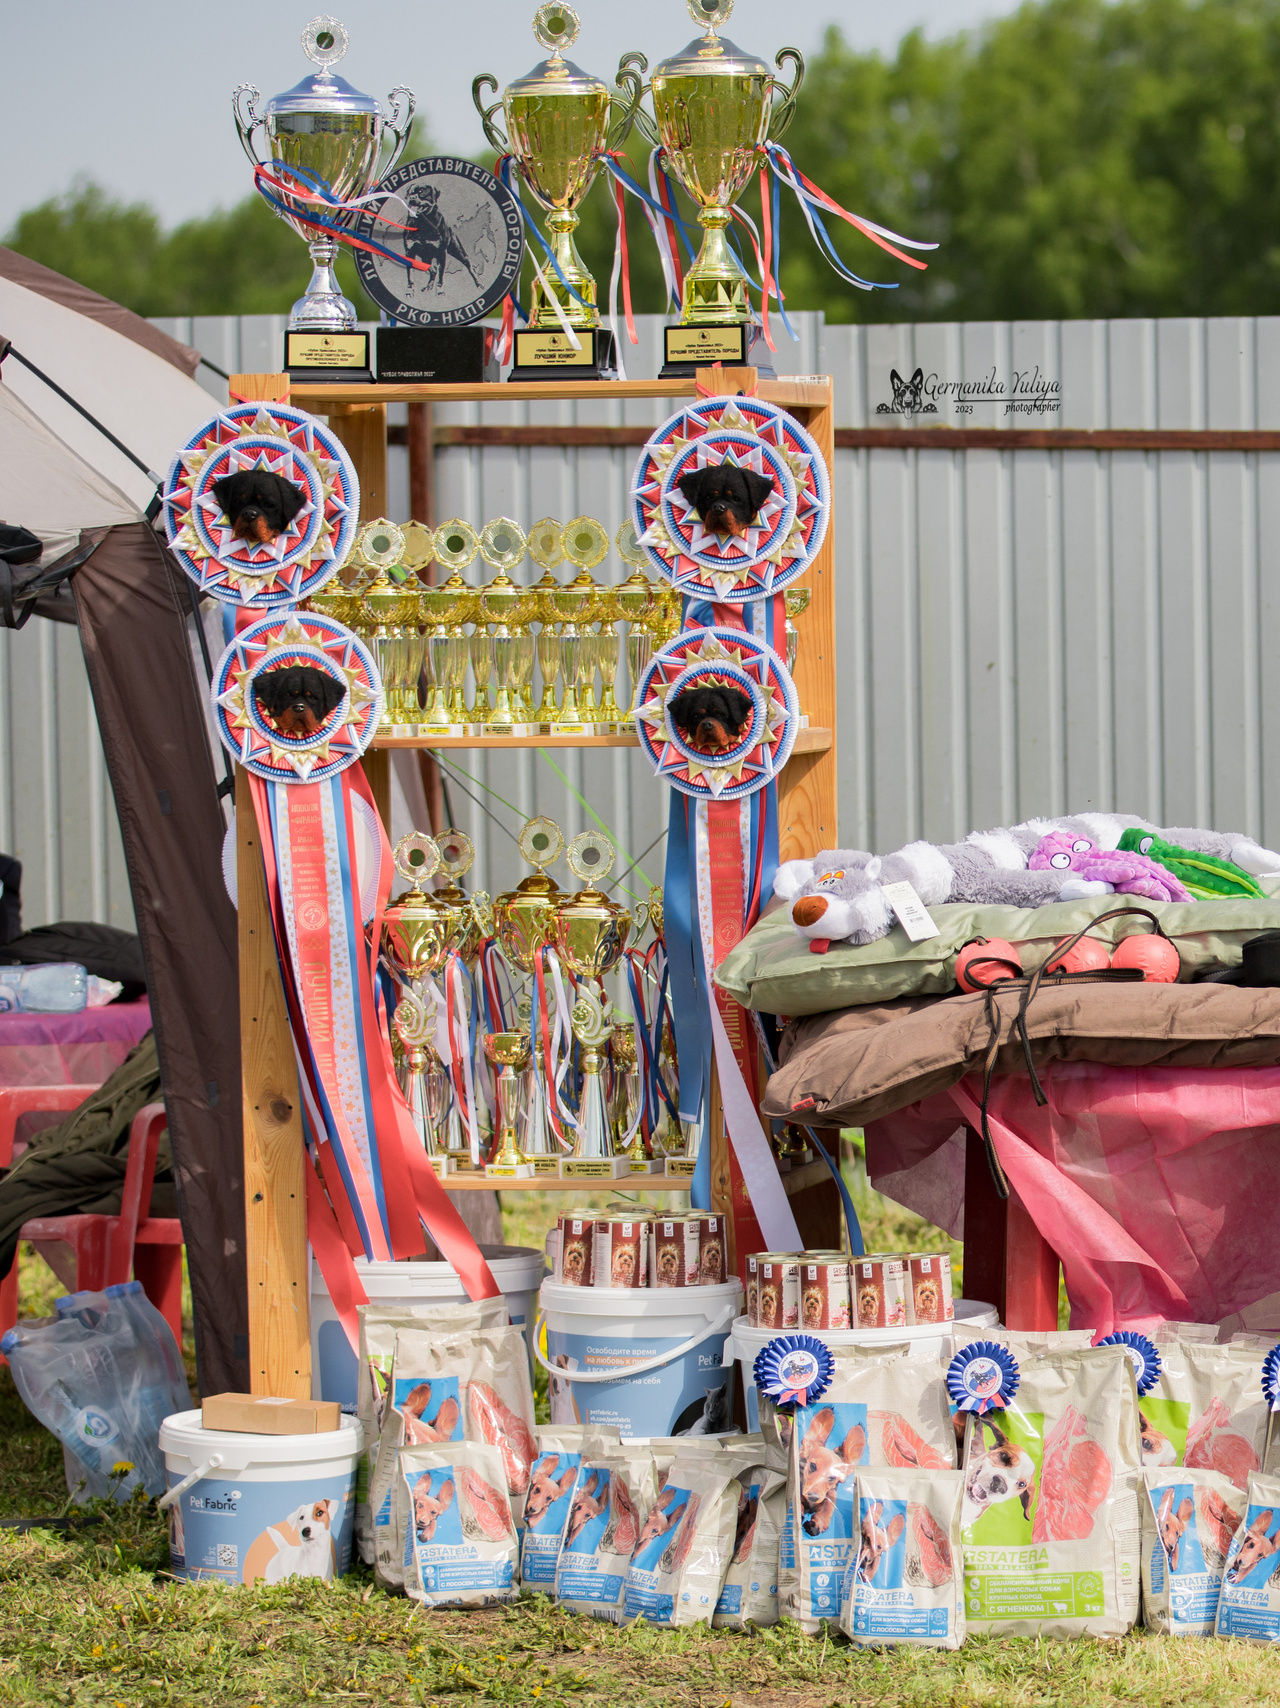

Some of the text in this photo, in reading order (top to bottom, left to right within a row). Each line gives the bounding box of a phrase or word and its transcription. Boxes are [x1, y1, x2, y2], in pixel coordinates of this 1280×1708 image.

[381, 159, 518, 280] ПРЕДСТАВИТЕЛЬ ПОРОДЫ
[396, 297, 486, 324] РКФ-НКПР
[304, 962, 333, 1042] ЛУЧШИЙ
[586, 1346, 657, 1356] Освободите время
[698, 1355, 713, 1366] Pet
[643, 1376, 661, 1385] себя
[590, 1416, 632, 1424] vk.com/petfabric
[190, 1496, 237, 1511] Pet Fabric
[428, 1546, 478, 1557] STATERA
[976, 1548, 1049, 1563] STATERA
[1053, 1577, 1070, 1585] КОРМ
[865, 1591, 914, 1601] STATERA
[1227, 1589, 1269, 1602] STATERA
[997, 1604, 1045, 1613] ЯГНЕНКОМ
[1084, 1604, 1091, 1612] 3
[1236, 1627, 1260, 1635] ЛОСОСЕМ
